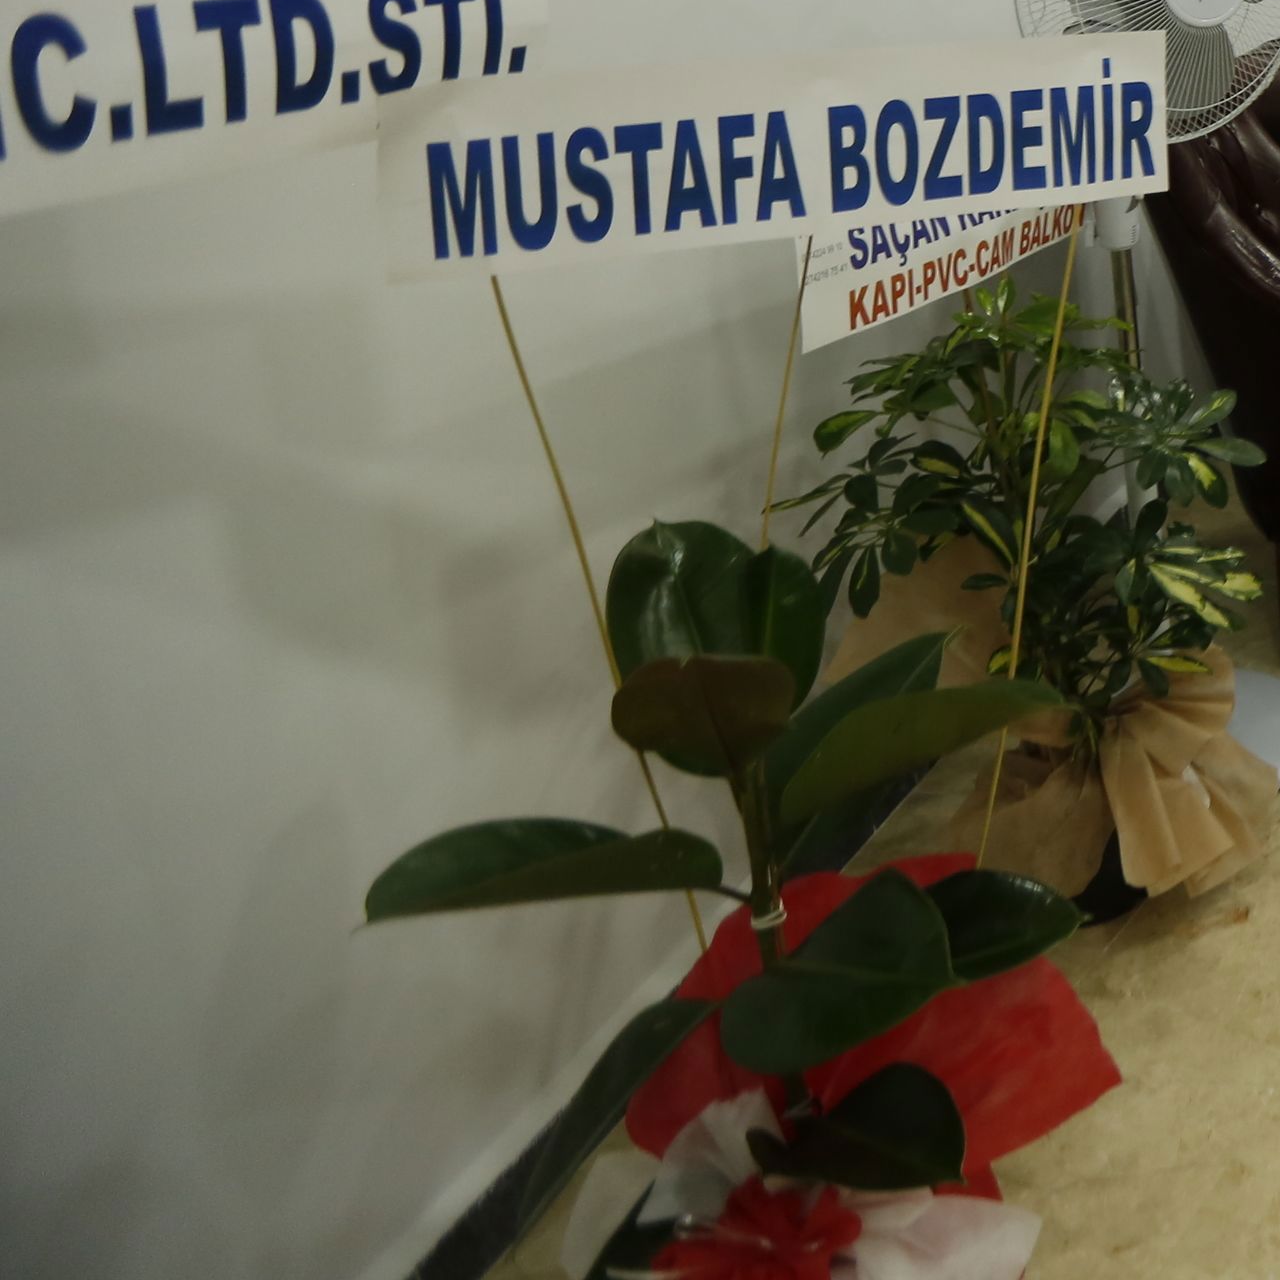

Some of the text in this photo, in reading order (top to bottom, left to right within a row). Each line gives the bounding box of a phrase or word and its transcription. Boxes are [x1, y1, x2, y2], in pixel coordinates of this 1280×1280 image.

[426, 57, 1155, 260] MUSTAFA BOZDEMİR
[849, 226, 1015, 330] KAPI-PVC-CAM
